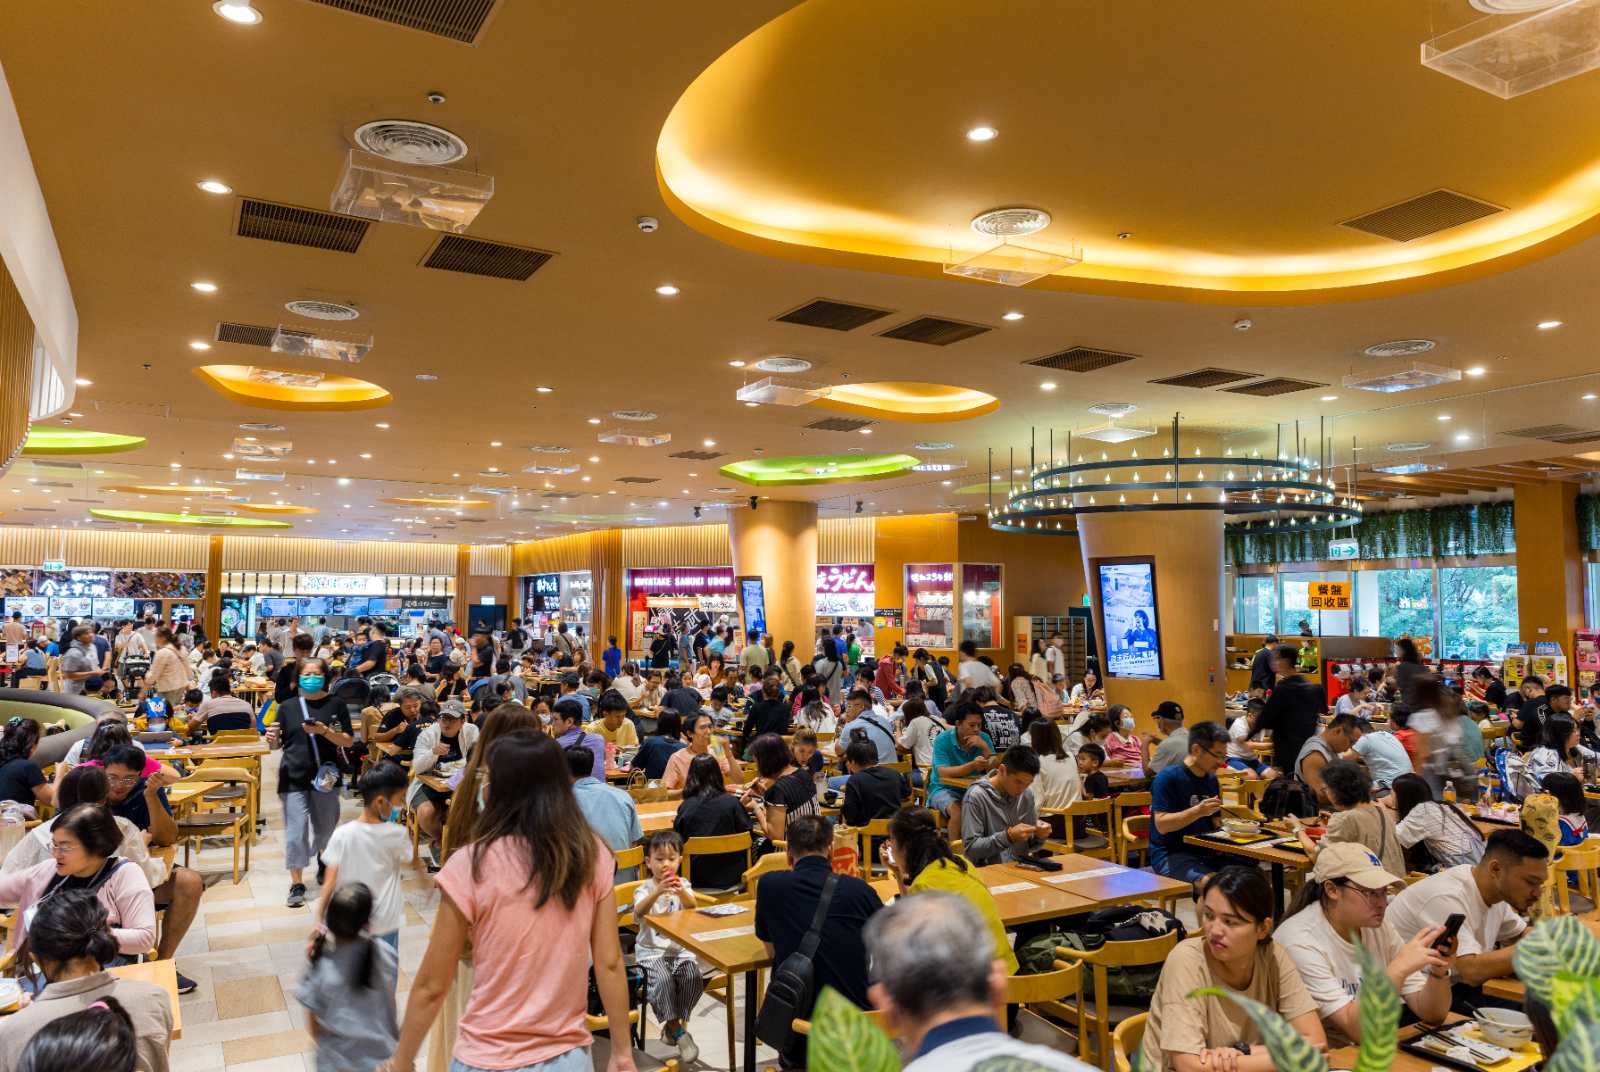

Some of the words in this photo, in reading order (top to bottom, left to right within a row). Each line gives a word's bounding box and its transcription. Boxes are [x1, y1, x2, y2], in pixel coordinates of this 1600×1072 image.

[674, 577, 704, 586] SANUKI
[707, 577, 731, 586] UDON
[1317, 584, 1342, 595] 餐盤
[1311, 597, 1349, 607] 回收區
